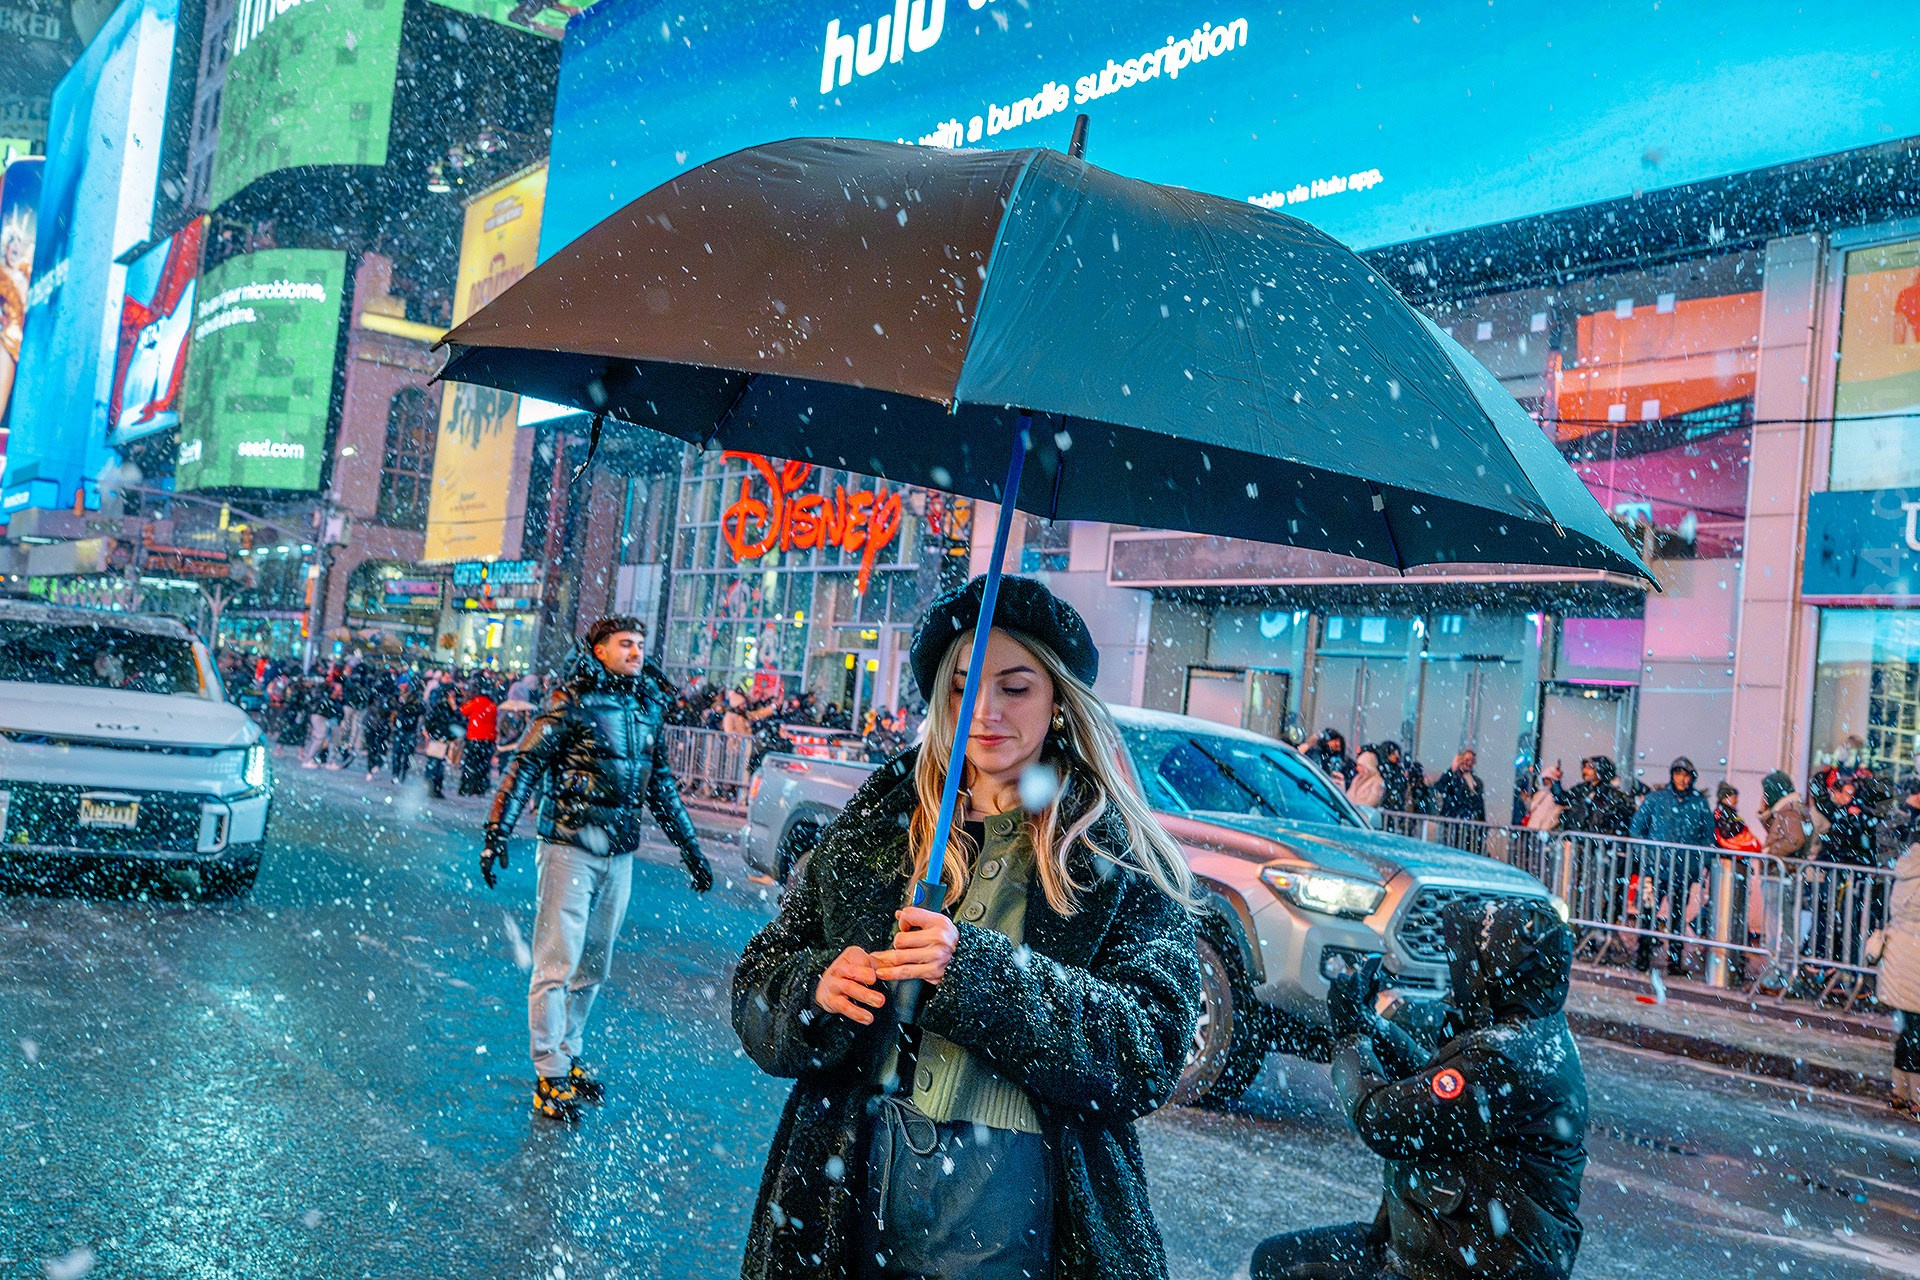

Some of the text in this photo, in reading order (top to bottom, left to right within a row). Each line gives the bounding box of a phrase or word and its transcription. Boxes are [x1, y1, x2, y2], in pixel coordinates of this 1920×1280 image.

[820, 0, 947, 94] hulu
[967, 116, 983, 142] a
[987, 82, 1070, 136] bundle
[1074, 17, 1248, 105] subscription
[1287, 184, 1309, 204] via
[1311, 175, 1347, 198] Hulu
[1348, 168, 1383, 192] app.
[241, 279, 326, 303] microbiome,
[238, 438, 304, 459] seed.com
